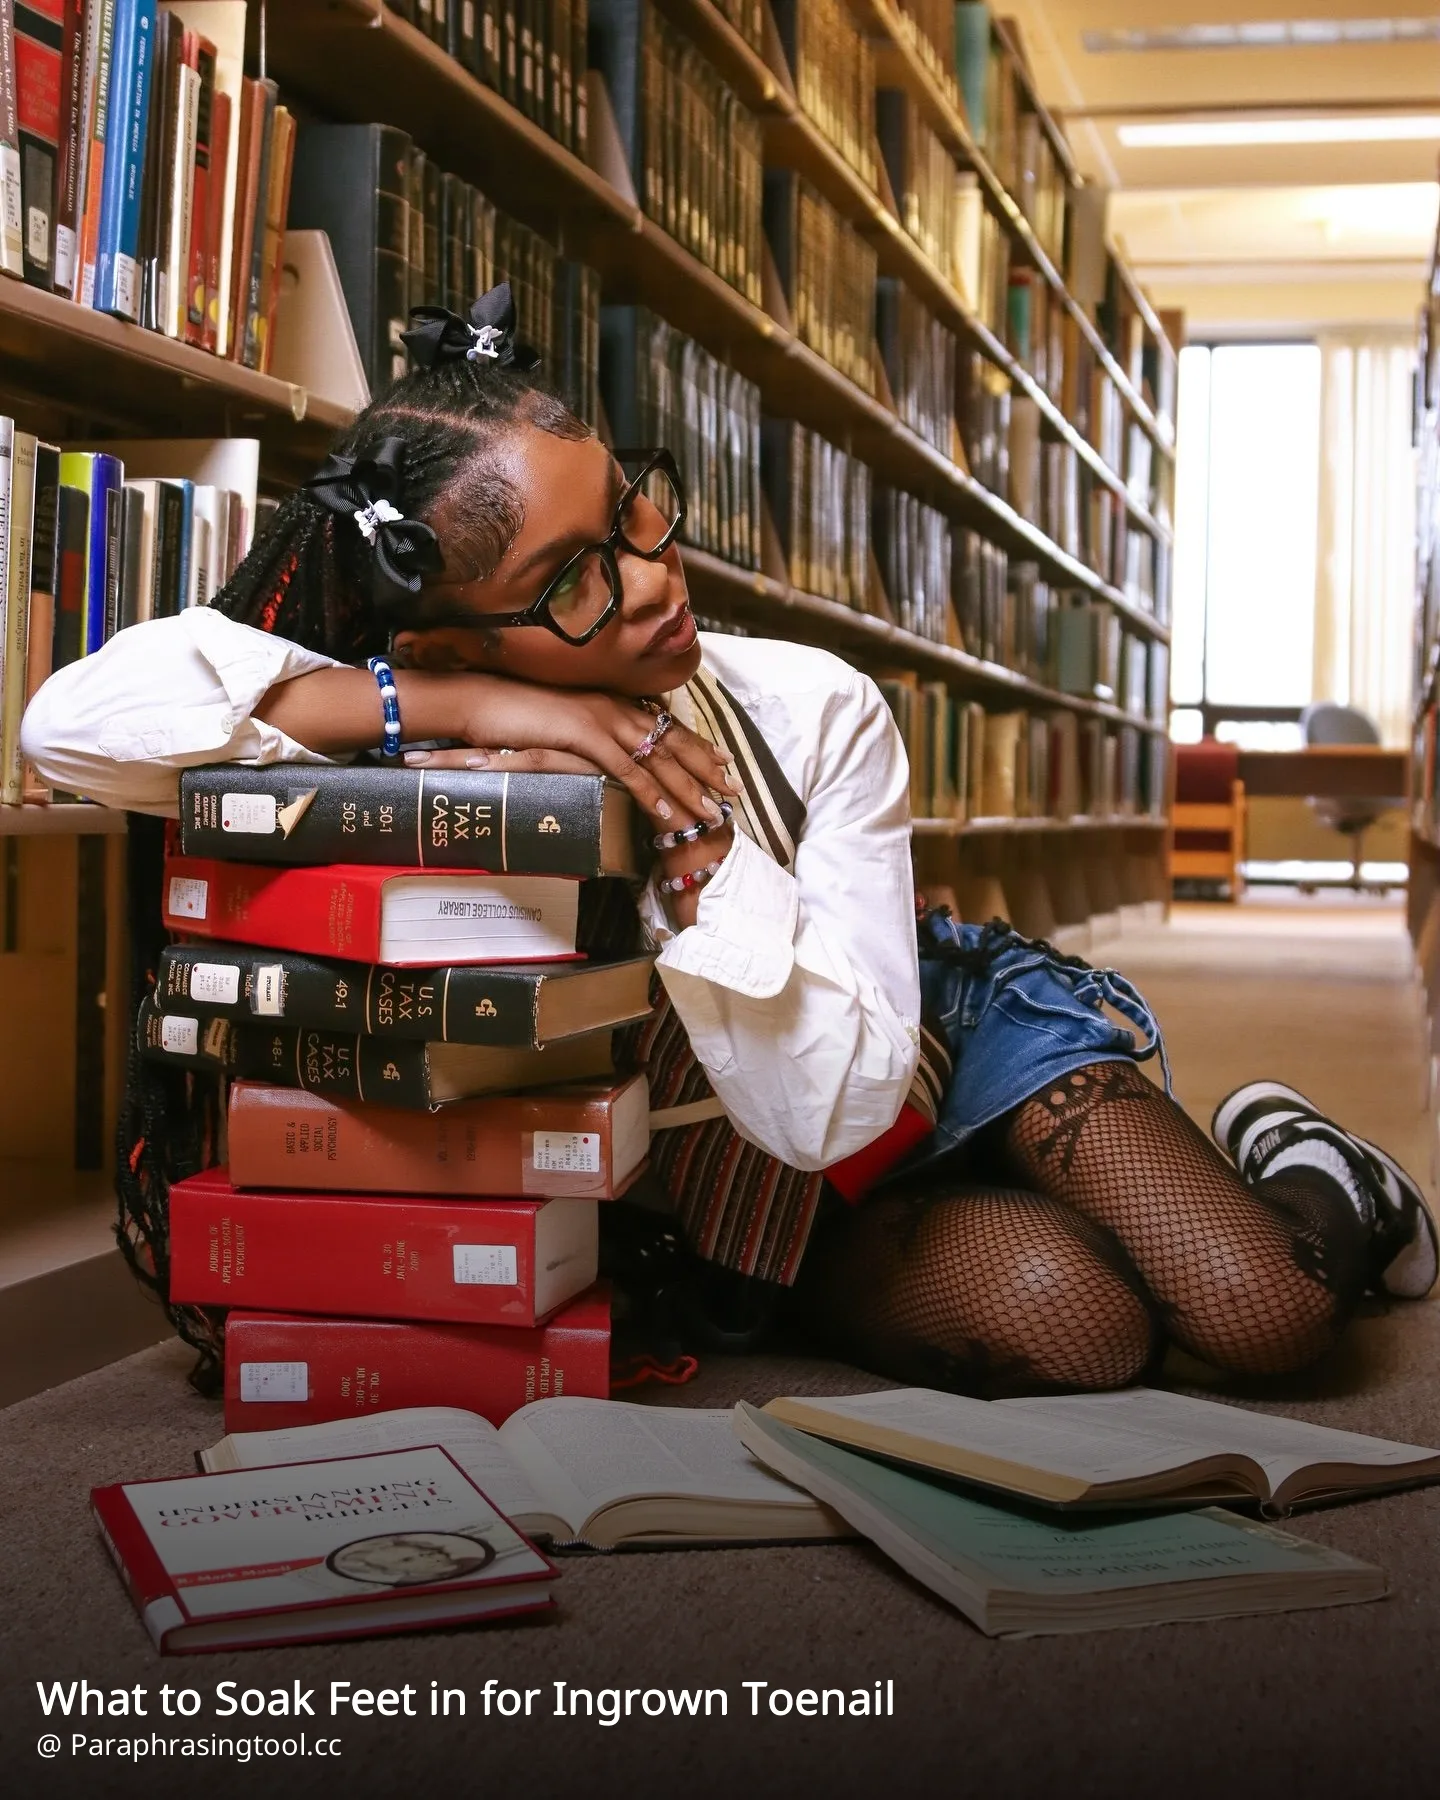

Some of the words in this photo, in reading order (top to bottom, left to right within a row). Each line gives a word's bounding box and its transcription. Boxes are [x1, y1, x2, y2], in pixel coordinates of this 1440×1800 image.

[102, 30, 111, 50] ARE
[102, 51, 109, 60] A
[138, 35, 146, 66] FEDERAL
[72, 54, 80, 87] Crisis
[98, 62, 109, 106] WOMAN'S
[135, 71, 144, 110] TAXATION
[96, 108, 106, 138] ISSUE
[132, 120, 140, 153] AMERICA
[66, 128, 78, 212] Administration
[16, 570, 24, 602] Policy
[16, 606, 24, 650] Analysis
[342, 802, 356, 833] 50-2
[363, 810, 373, 827] and
[379, 805, 393, 834] 50-1
[432, 794, 449, 847] CASES
[454, 802, 471, 840] TAX
[346, 892, 354, 930] JOURNAL
[438, 901, 471, 916] LIBRARY
[472, 903, 507, 918] COLLEGE
[508, 905, 542, 922] CANISIUS
[174, 964, 182, 992] CLEARING
[182, 963, 190, 996] COMMERCE
[244, 974, 254, 998] Index
[335, 979, 348, 1010] 49-1
[378, 972, 396, 1025] CASES
[398, 983, 415, 1020] TAX
[272, 1036, 284, 1068] 48-1
[306, 1033, 320, 1084] CASES
[323, 1044, 336, 1080] TAX
[286, 1130, 296, 1154] BASIC
[300, 1123, 310, 1153] APPLIED
[314, 1125, 324, 1152] SOCIAL
[328, 1116, 338, 1161] PSYCHOLOGY
[1252, 1128, 1282, 1164] NIKE
[210, 1225, 218, 1235] OF
[222, 1216, 231, 1247] SOCIAL
[210, 1238, 219, 1273] JOURNAL
[236, 1224, 246, 1276] PSYCHOLOGY
[384, 1244, 392, 1254] 30
[411, 1250, 419, 1272] 2000
[222, 1248, 232, 1284] APPLIED
[341, 1376, 350, 1398] 2000
[540, 1357, 550, 1394] APPLIED
[370, 1392, 379, 1404] 30
[158, 1478, 436, 1518] UNDERSTANDING
[160, 1487, 438, 1528] GOVERNMENT
[304, 1497, 453, 1522] BUDGETS
[1041, 1562, 1170, 1578] BUDGET
